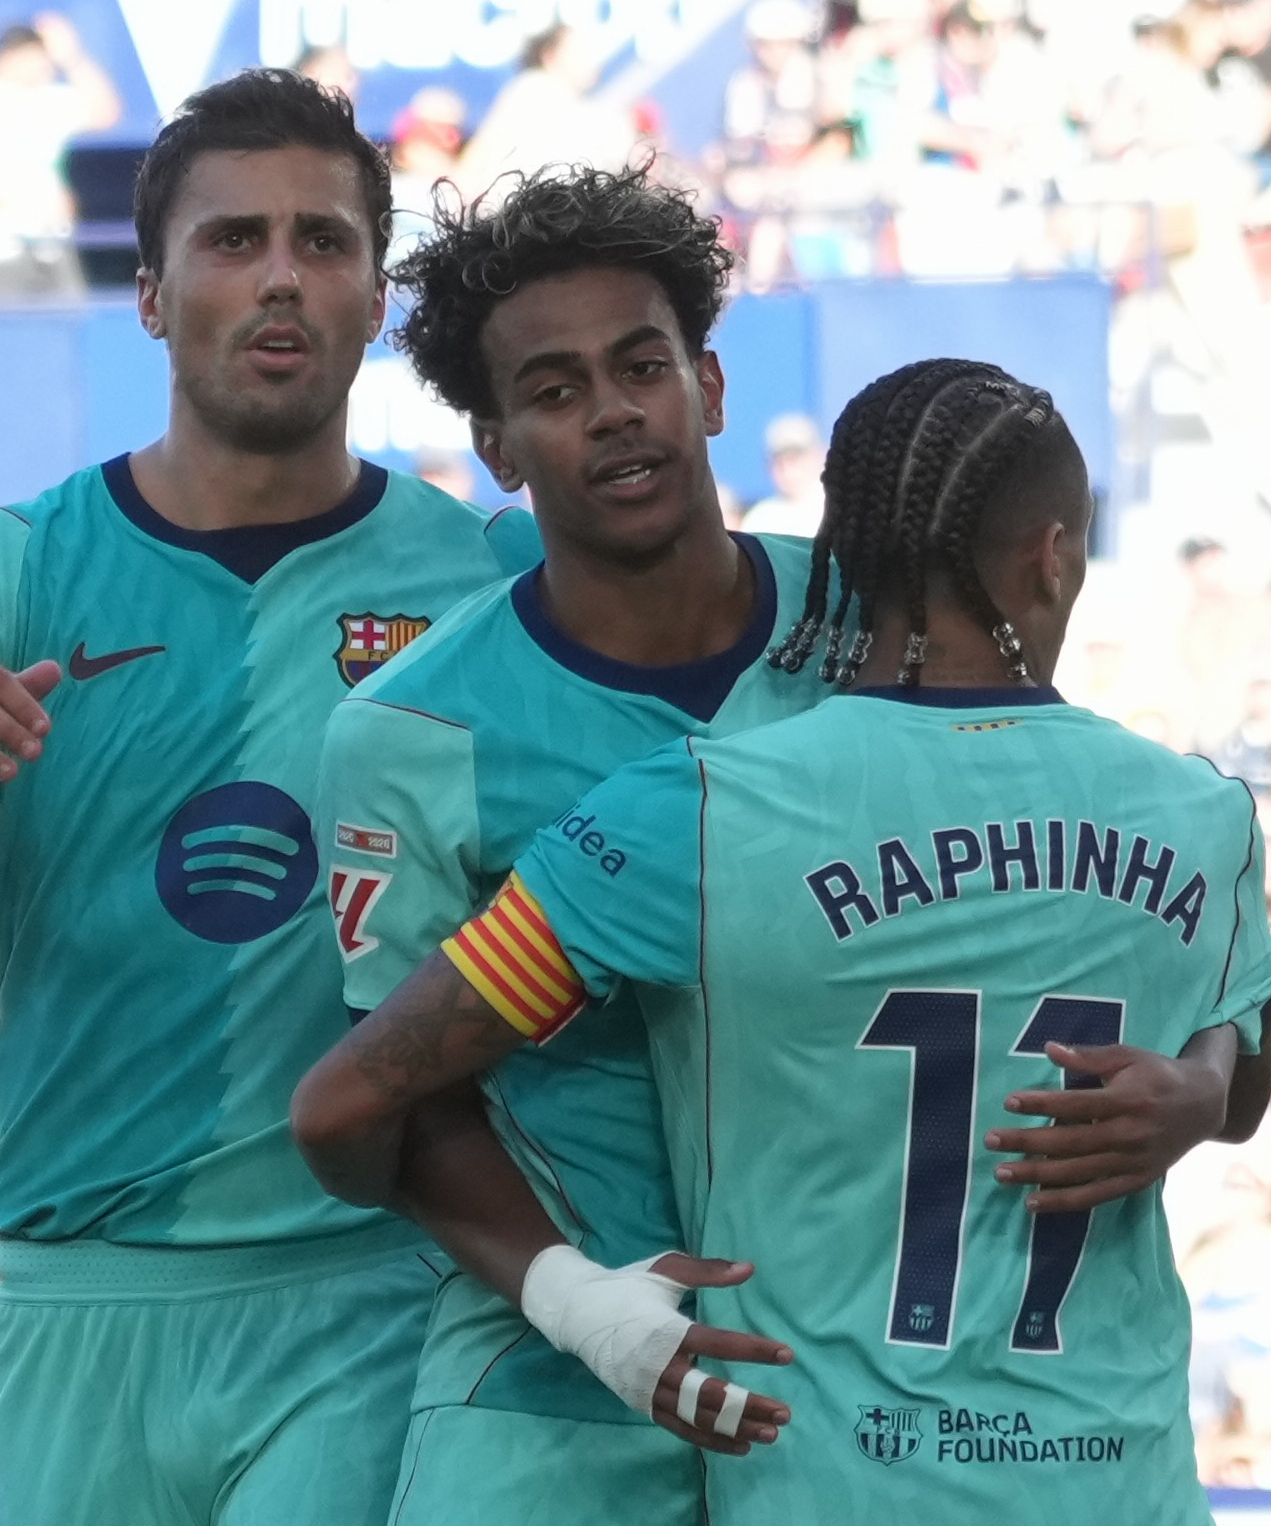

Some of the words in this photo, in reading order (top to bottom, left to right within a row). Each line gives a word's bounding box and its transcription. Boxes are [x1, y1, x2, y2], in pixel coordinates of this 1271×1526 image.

[803, 818, 1208, 948] RAPHINHA
[854, 987, 1127, 1354] 11
[937, 1407, 1034, 1437] BARÇA
[937, 1436, 1125, 1464] FOUNDATION
